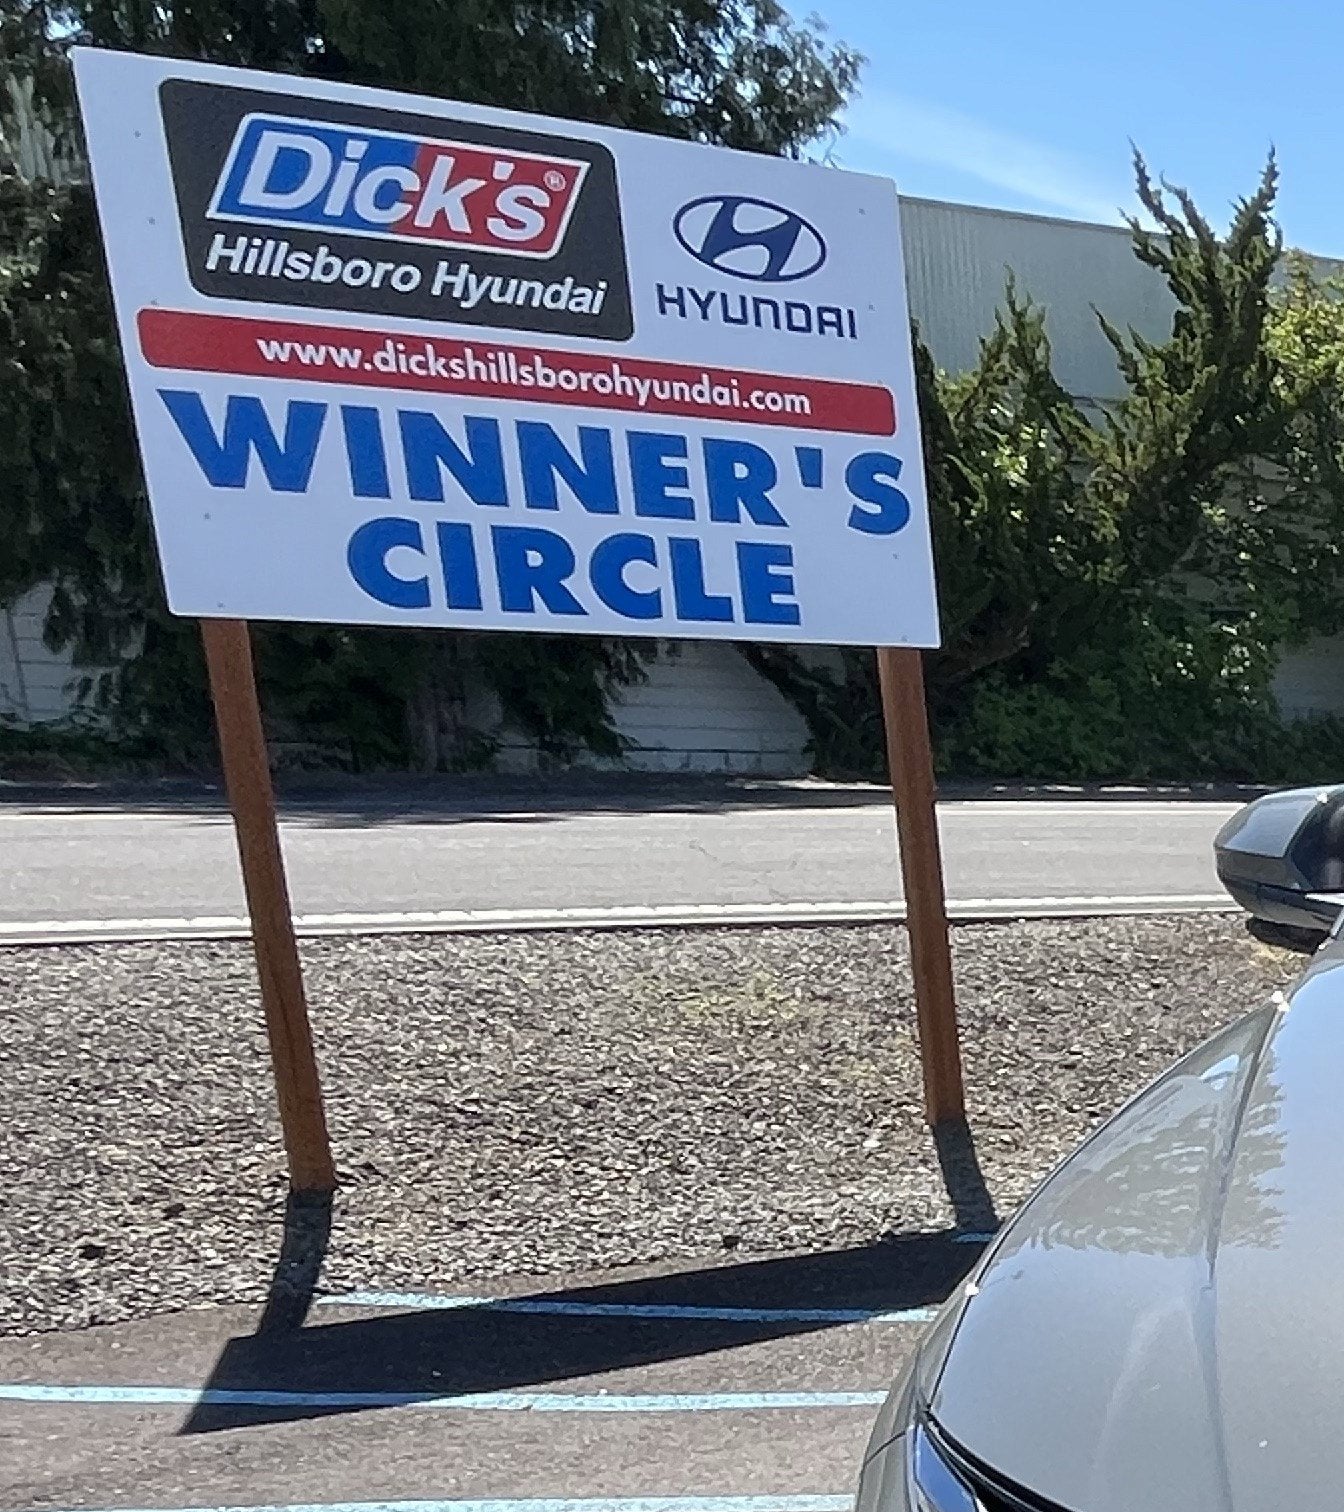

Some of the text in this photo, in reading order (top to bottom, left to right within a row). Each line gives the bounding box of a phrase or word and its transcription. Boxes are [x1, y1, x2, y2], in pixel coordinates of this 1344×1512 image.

[205, 234, 608, 316] Hillsboro Hyundai
[656, 283, 859, 340] HYUNDAI
[256, 337, 812, 415] www.dickshillsborohyundai.com
[156, 389, 912, 536] WINNER'S
[346, 516, 801, 626] CIRCLE
